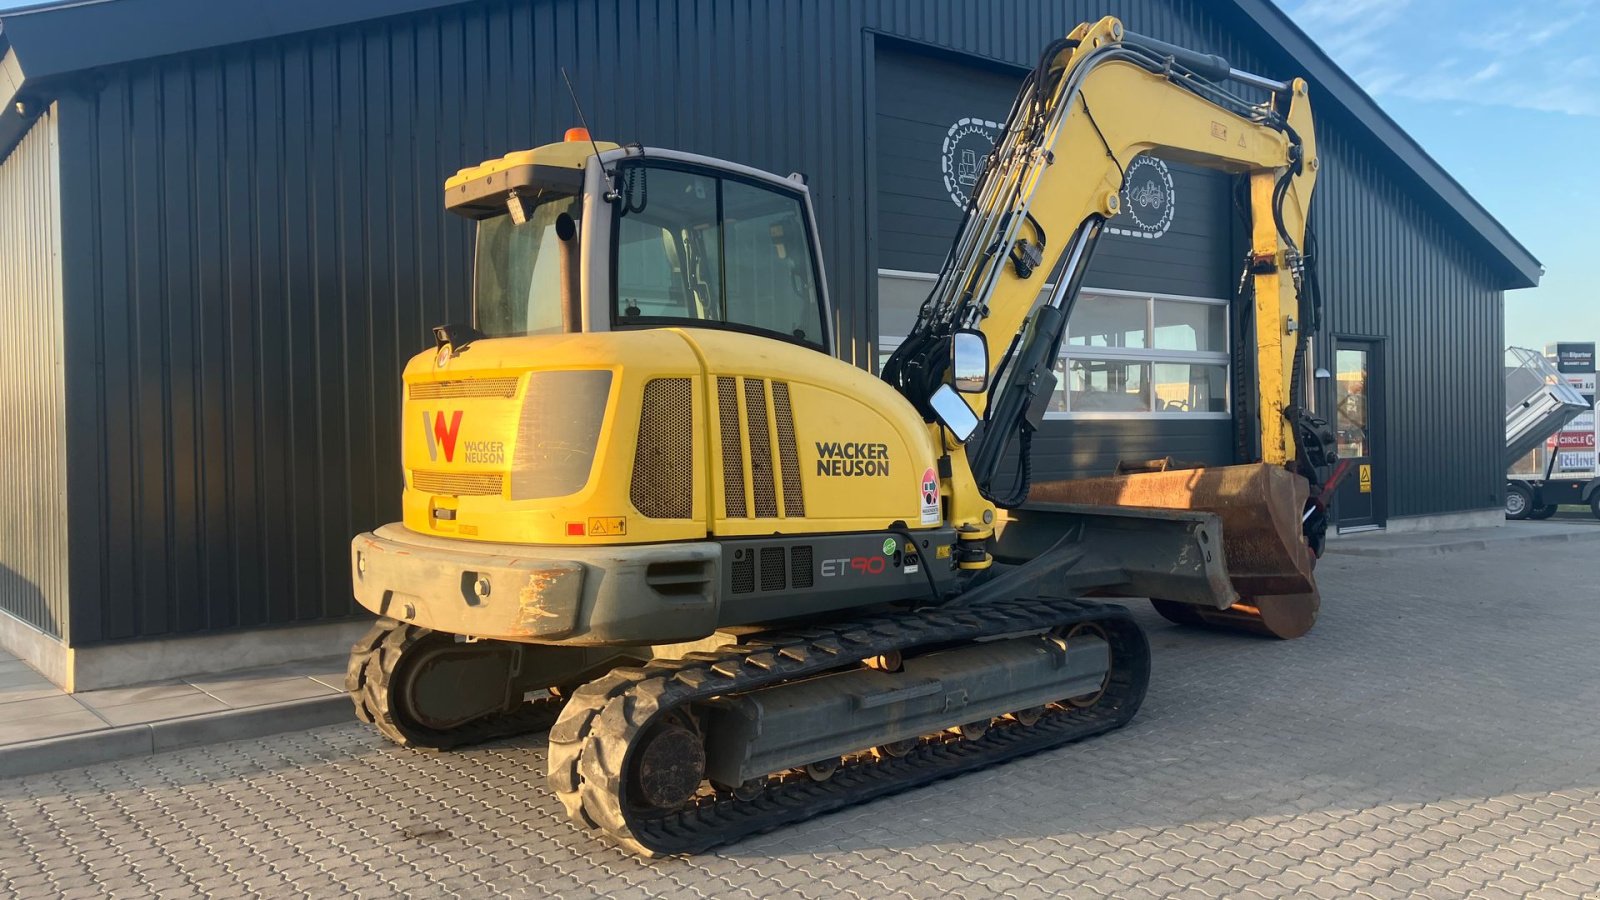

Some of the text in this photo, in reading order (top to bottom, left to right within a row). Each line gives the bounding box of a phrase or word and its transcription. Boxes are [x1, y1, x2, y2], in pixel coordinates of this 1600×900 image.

[464, 441, 504, 453] WACKER
[1559, 436, 1585, 444] CIRCLE
[815, 441, 889, 460] WACKER
[465, 453, 505, 464] NEUSON
[816, 459, 889, 477] NEUSON
[821, 556, 886, 577] ET90
